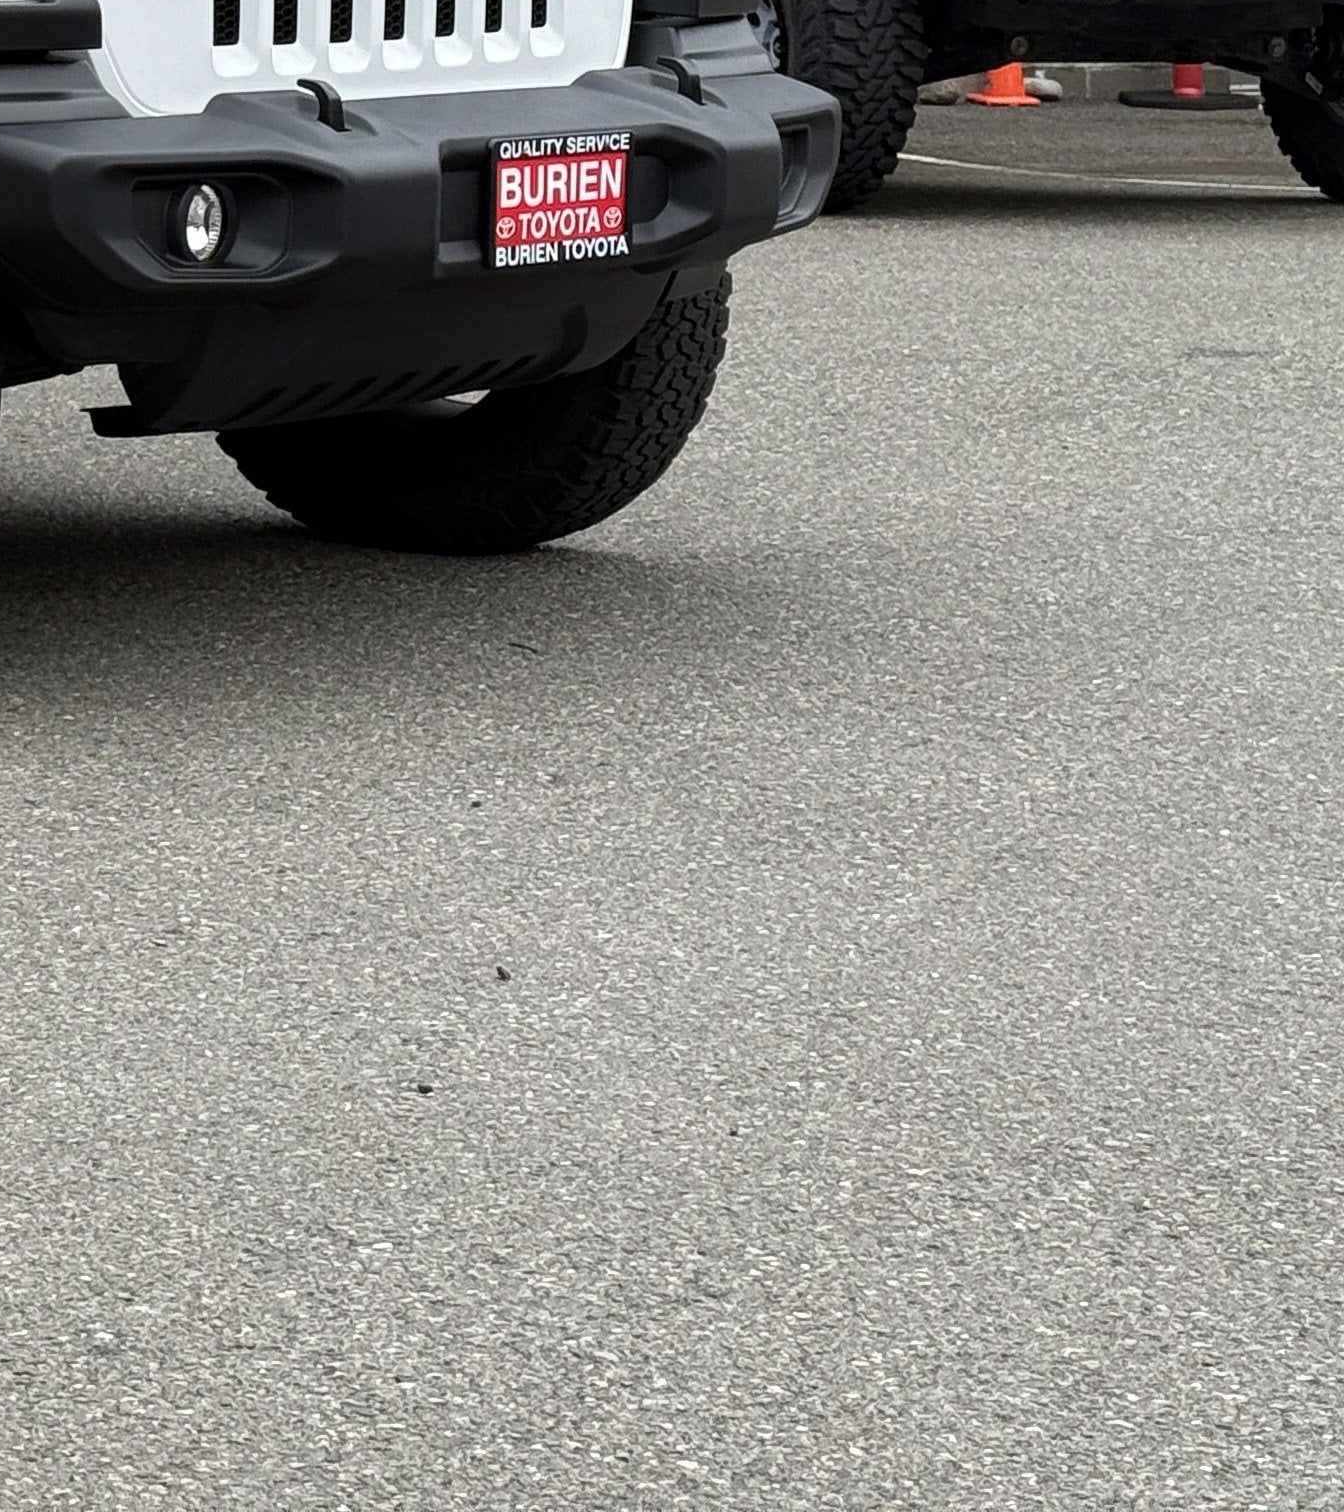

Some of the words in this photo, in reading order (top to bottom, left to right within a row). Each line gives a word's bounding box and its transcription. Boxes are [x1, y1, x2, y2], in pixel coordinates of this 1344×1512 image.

[500, 138, 563, 159] QUALITY
[566, 133, 631, 155] SERVICE
[500, 158, 623, 209] BURIEN
[518, 206, 601, 240] TOYOTA
[495, 244, 559, 267] BURIEN
[562, 235, 629, 260] TOYOTA
